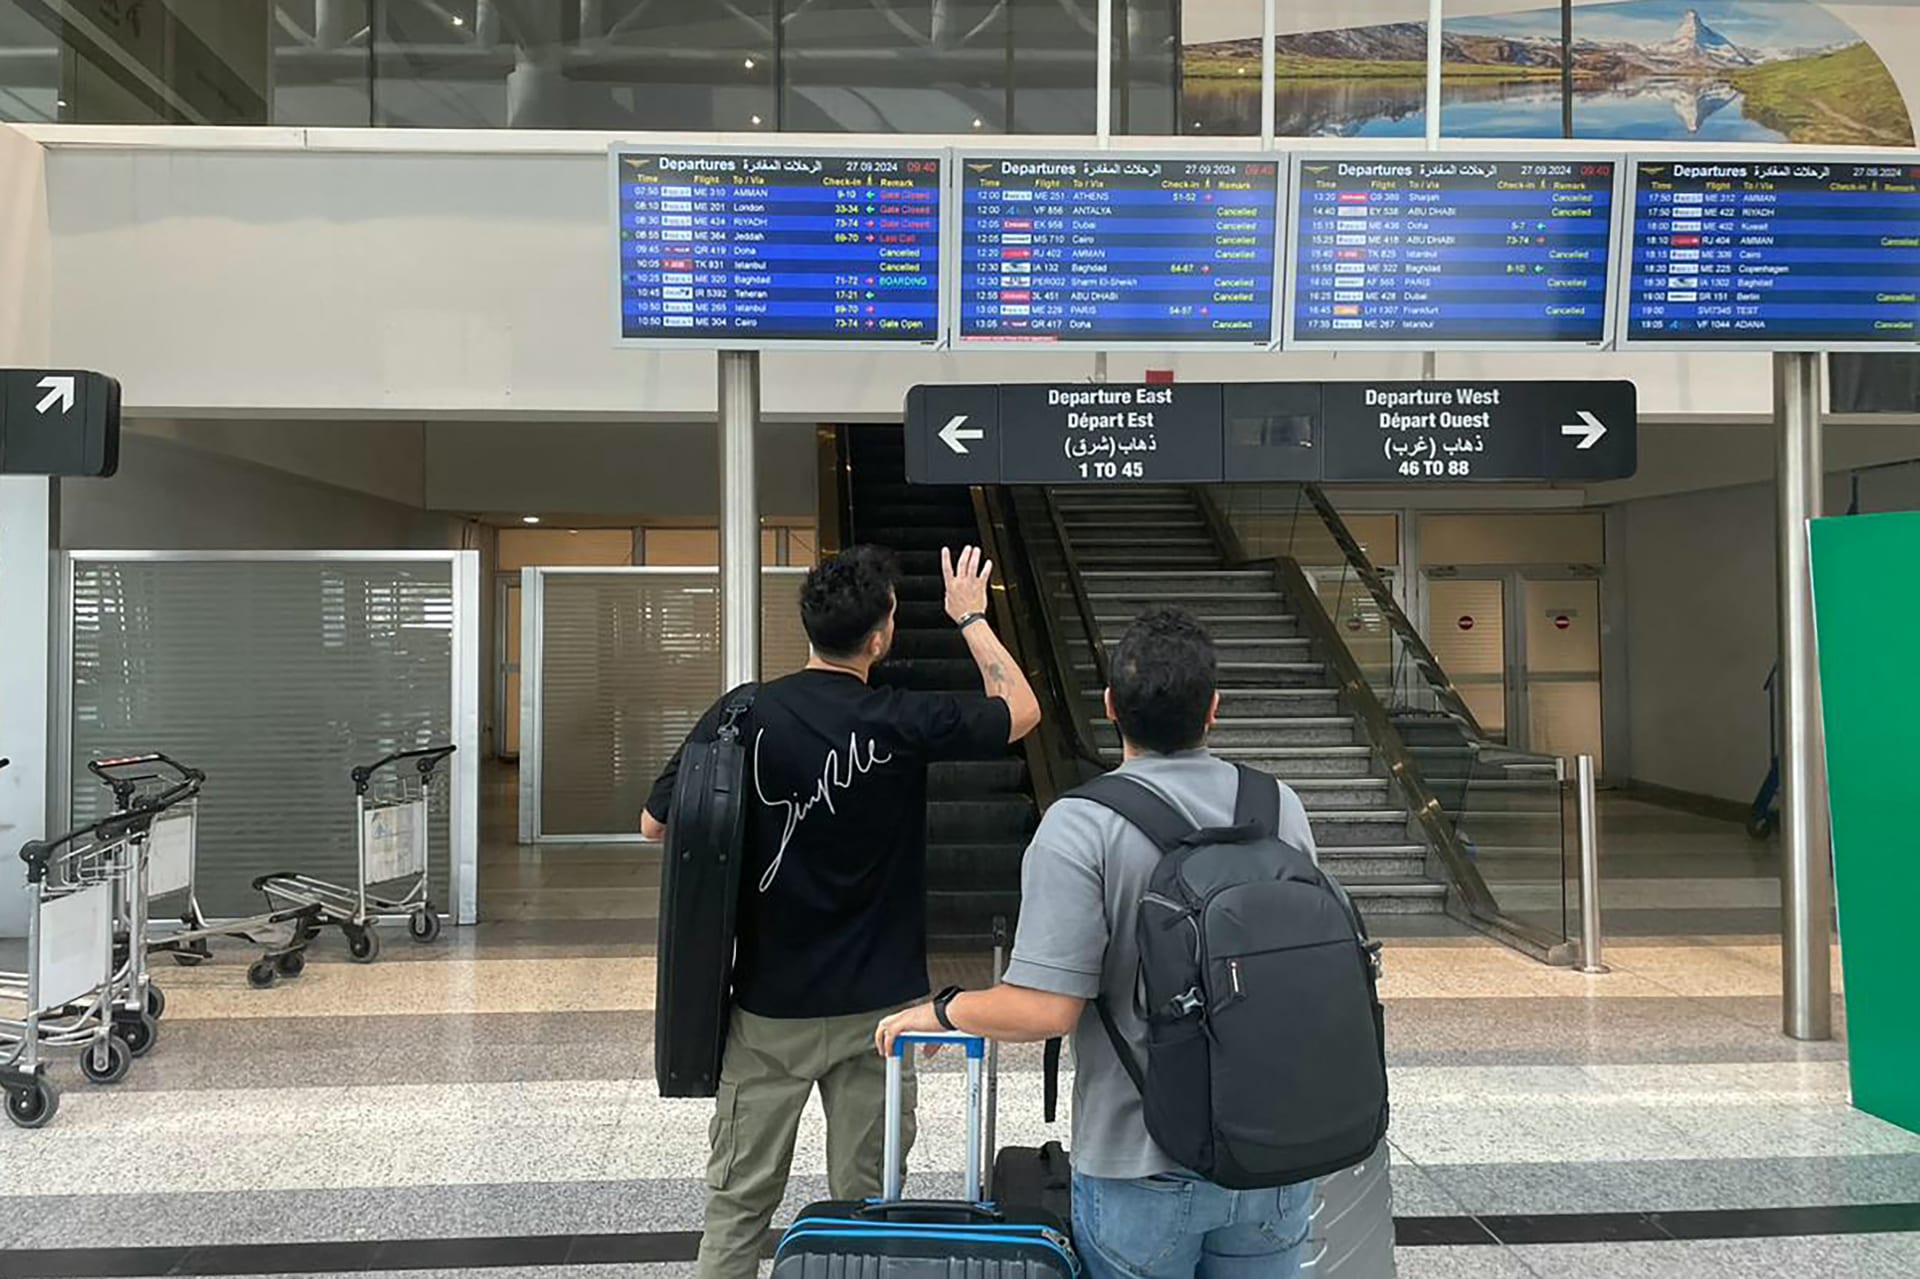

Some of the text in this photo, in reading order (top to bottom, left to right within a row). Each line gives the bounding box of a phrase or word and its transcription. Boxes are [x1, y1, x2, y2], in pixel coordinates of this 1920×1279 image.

[659, 157, 735, 171] Departures
[784, 160, 822, 173] الرحلات
[846, 162, 898, 171] 27.09.2024
[907, 163, 936, 172] 09:40
[1002, 162, 1076, 175] Departures
[1338, 164, 1412, 176] Departures
[1674, 165, 1747, 177] Departures
[694, 176, 719, 184] Flight
[823, 177, 861, 186] Check-in
[880, 179, 914, 187] Remark
[1035, 180, 1060, 189] Flight
[1552, 194, 1592, 202] Cancelled
[694, 203, 708, 211] ME
[1073, 207, 1111, 215] ANTALYA
[1217, 208, 1257, 216] Cancelled
[1408, 208, 1426, 216] ABU
[1552, 208, 1591, 216] Cancelled
[734, 218, 767, 226] RIYADH
[1216, 222, 1256, 230] Cancelled
[734, 233, 764, 241] Jeddah
[1072, 236, 1094, 244] Cairo
[1216, 236, 1256, 245] Cancelled
[734, 247, 756, 255] Doha
[879, 249, 920, 257] Cancelled
[1740, 251, 1760, 259] Cairo
[735, 261, 767, 269] Istanbul
[879, 263, 920, 271] Cancelled
[1072, 264, 1107, 273] Baghdad
[1739, 265, 1789, 274] Copenhagen
[735, 275, 770, 284] Baghdad
[879, 277, 927, 285] BOARDING
[1214, 279, 1254, 287] Cancelled
[1214, 293, 1254, 301] Cancelled
[879, 320, 899, 328] Gate
[901, 320, 923, 329] Open
[1049, 389, 1172, 407] Departure East
[1365, 389, 1500, 407] Departure West
[1068, 413, 1153, 430] Départ Est
[1380, 413, 1490, 430] Départ Ouest
[1065, 434, 1156, 458] ذهاب (شرق)
[1385, 436, 1483, 459] ذهاب (غرب)
[1079, 463, 1143, 478] 1 TO 45
[1399, 461, 1469, 475] 46 TO 88
[754, 728, 891, 892] Simple
